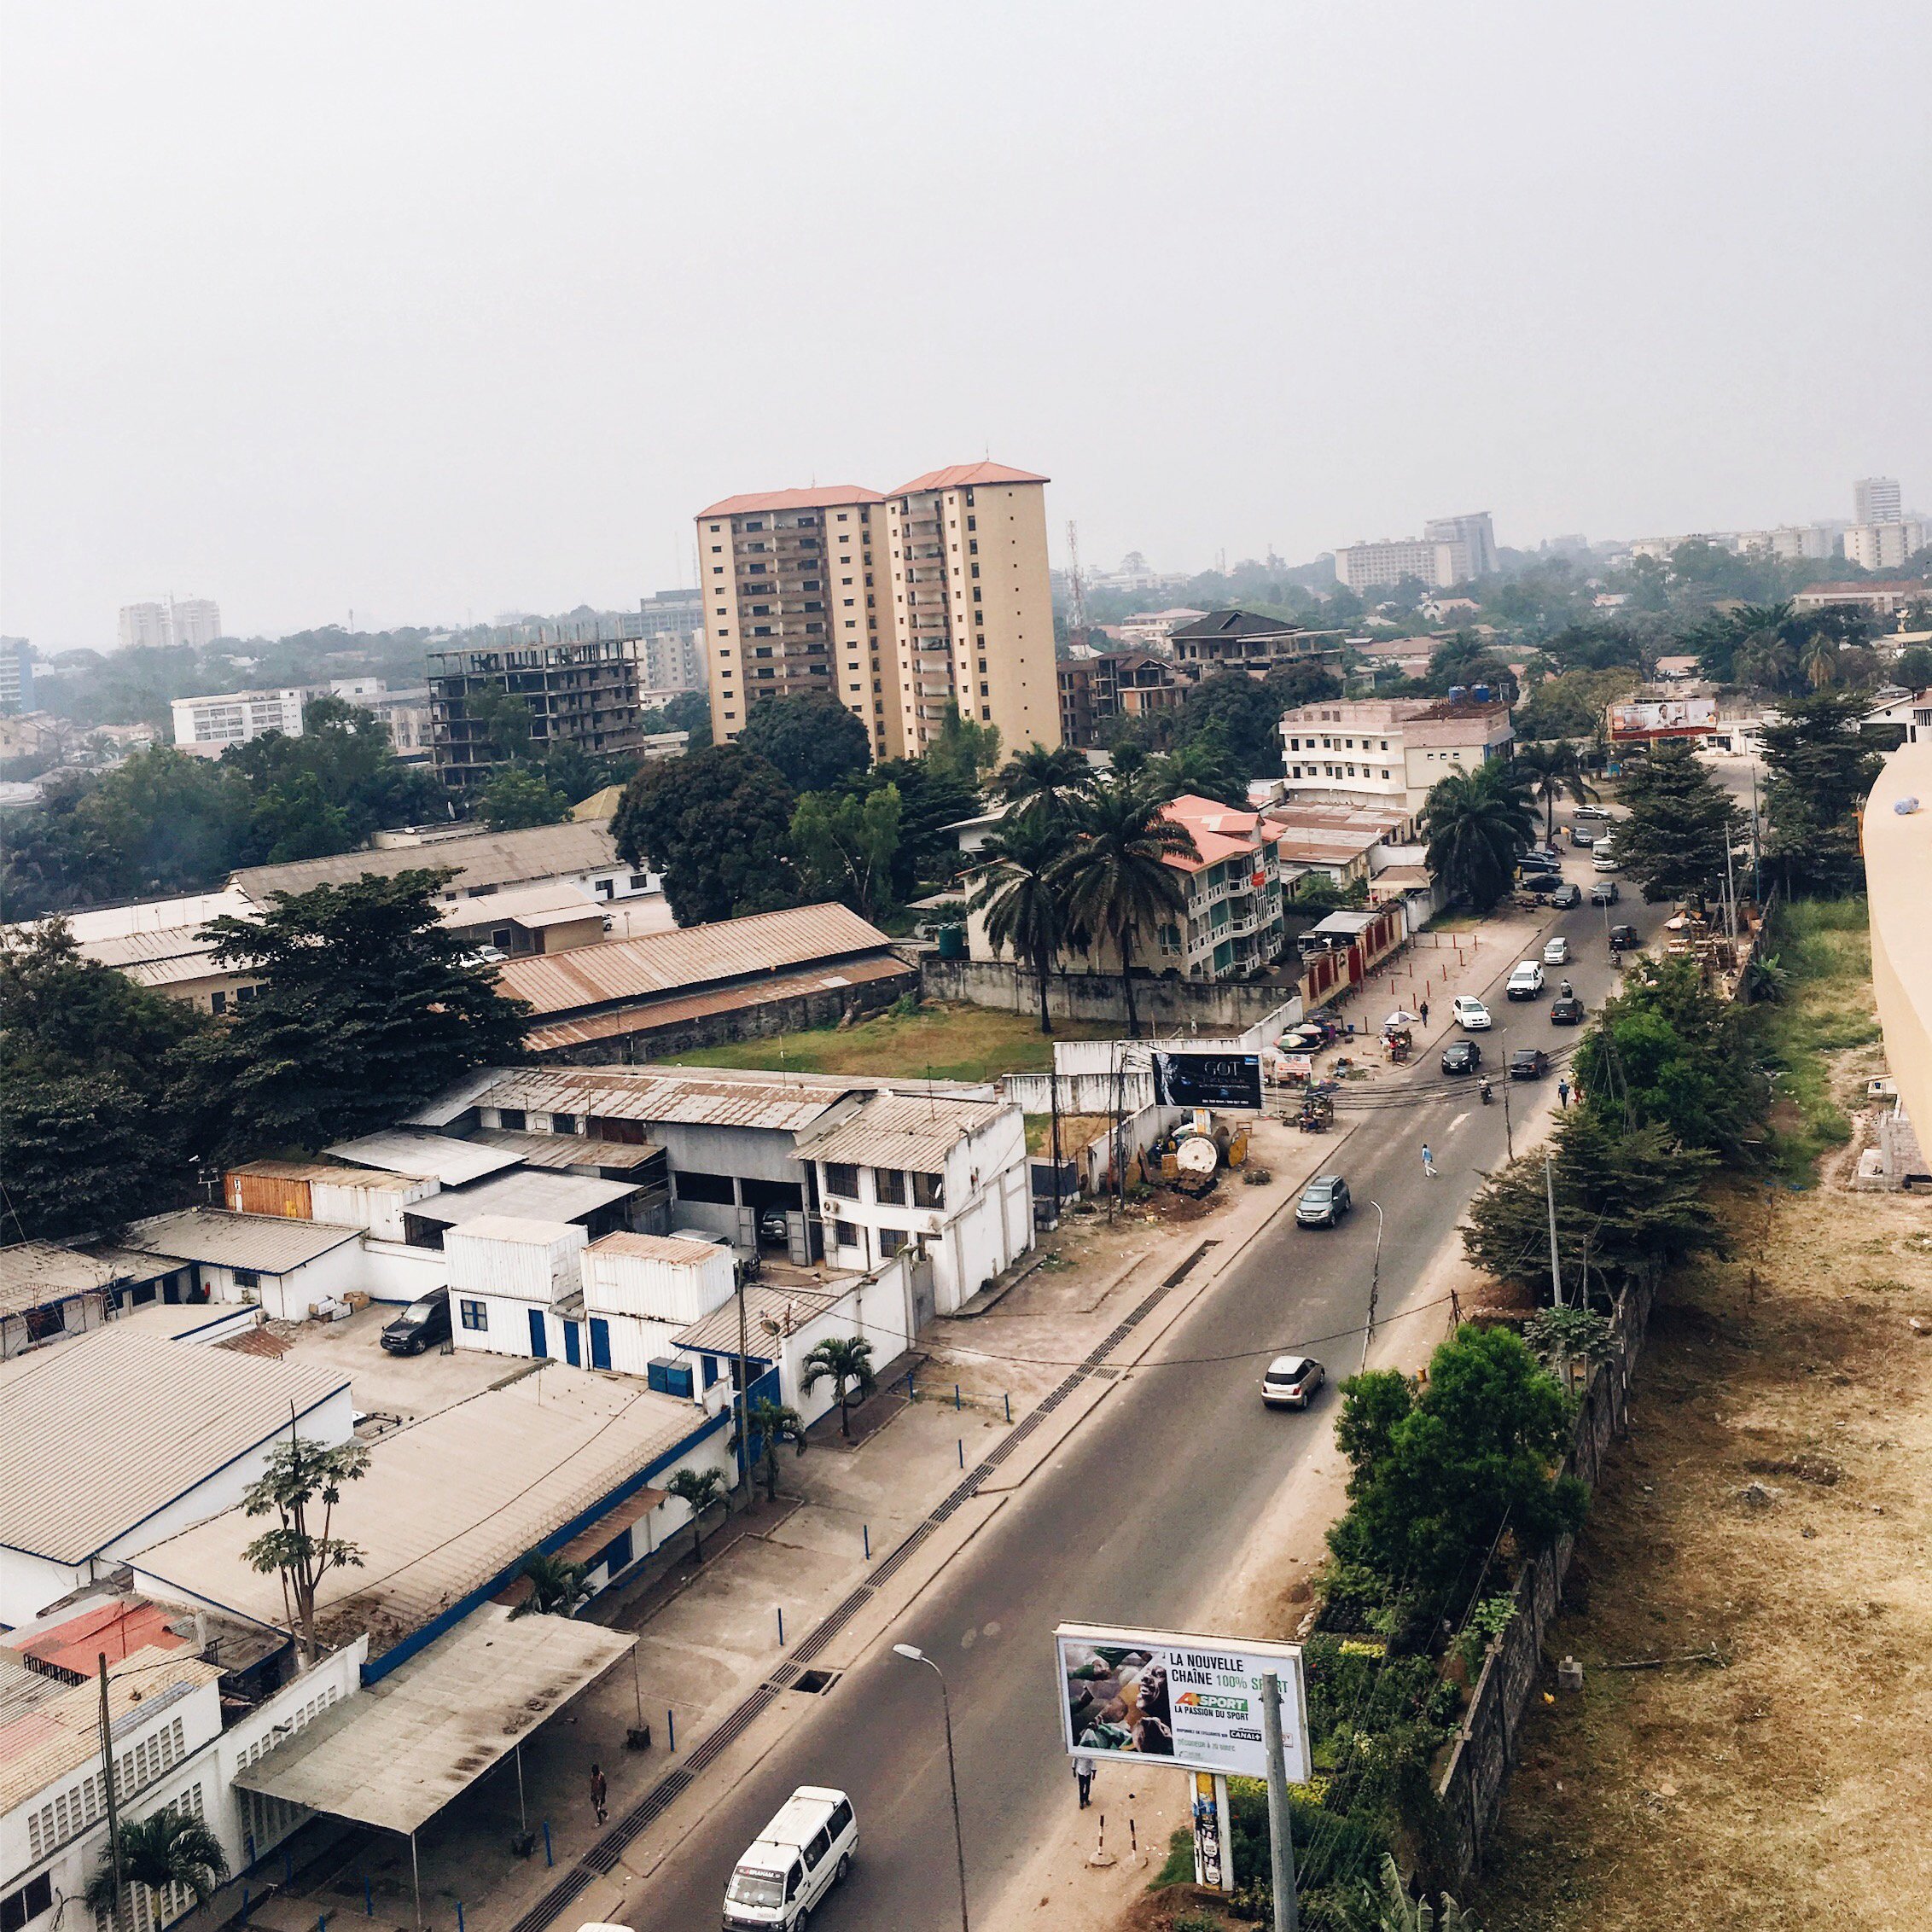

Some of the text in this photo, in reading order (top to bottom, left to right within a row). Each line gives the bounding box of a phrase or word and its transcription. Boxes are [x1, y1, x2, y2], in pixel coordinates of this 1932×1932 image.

[1170, 1652, 1184, 1667] LA
[1187, 1654, 1244, 1673] NOUVELLE
[1172, 1668, 1213, 1685] CHAÎNE
[1216, 1674, 1248, 1689] 100%
[1199, 1695, 1245, 1711] SPORT
[1174, 1705, 1249, 1721] LA PASSION DU SPORT
[1230, 1730, 1261, 1741] CANAL+
